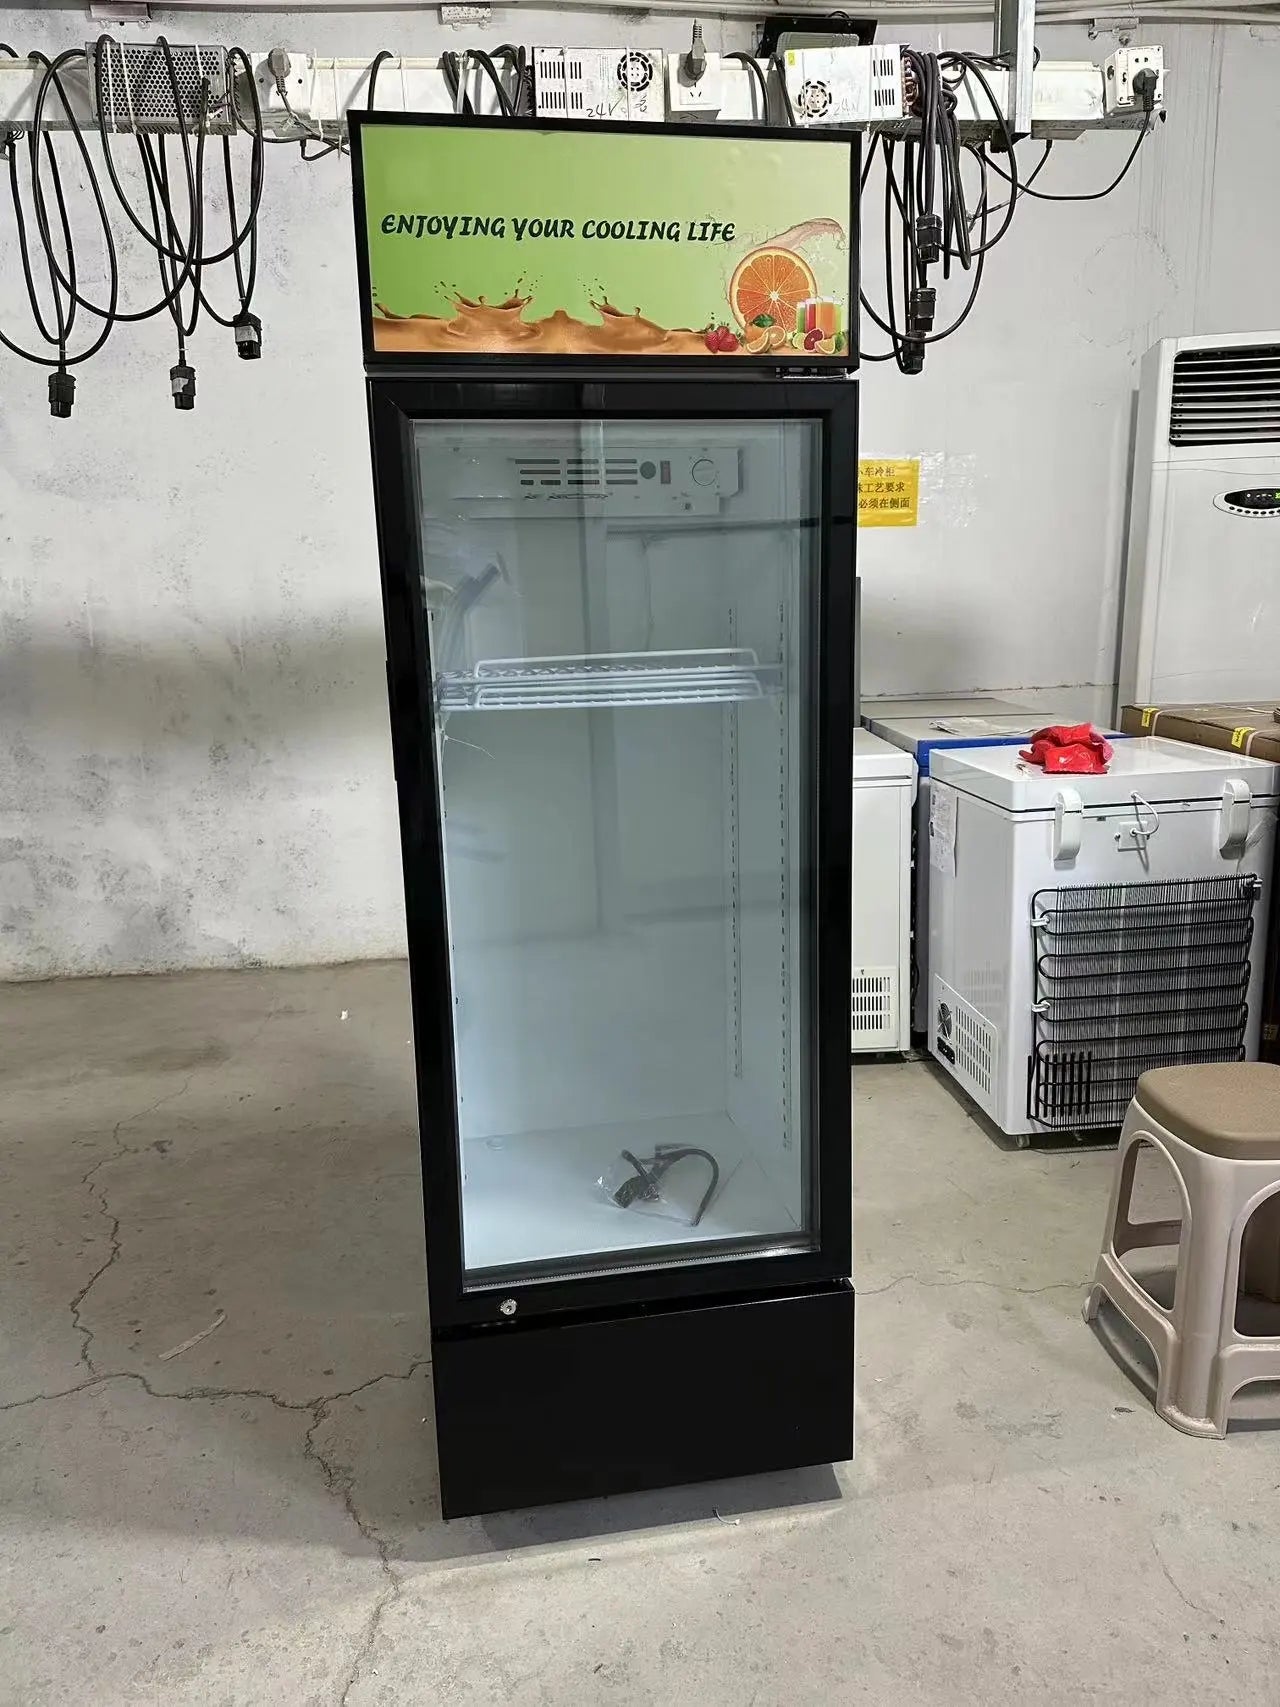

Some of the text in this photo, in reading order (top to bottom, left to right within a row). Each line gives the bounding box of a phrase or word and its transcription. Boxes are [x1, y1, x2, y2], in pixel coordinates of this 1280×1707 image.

[381, 214, 736, 242] ENJOYING YOUR COOLING LIFE
